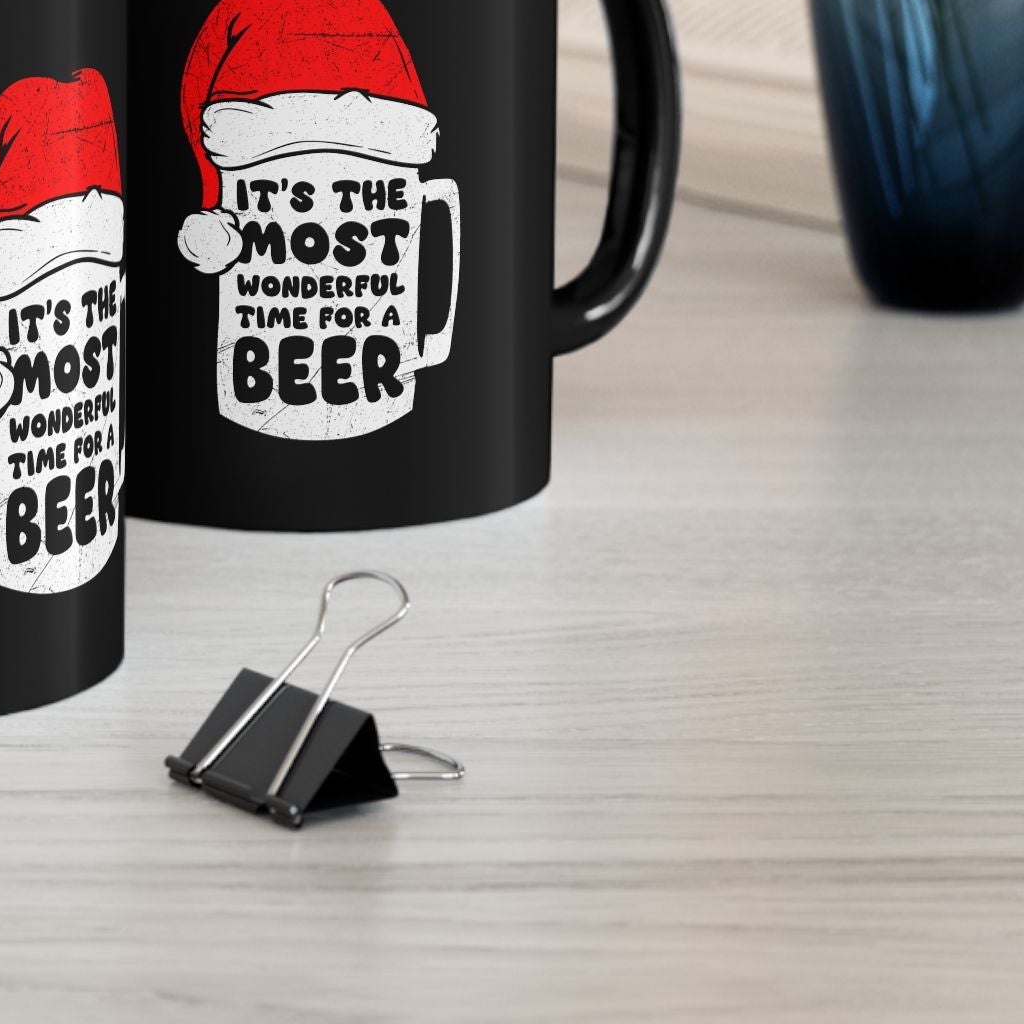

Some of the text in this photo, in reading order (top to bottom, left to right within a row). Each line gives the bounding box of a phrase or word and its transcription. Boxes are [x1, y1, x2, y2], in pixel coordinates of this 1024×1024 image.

[236, 178, 408, 212] IT'S THE
[238, 218, 410, 267] MOST
[8, 280, 117, 345] IT'S THE
[236, 273, 405, 299] WONDERFUL
[235, 305, 400, 329] TIME FOR A
[11, 325, 118, 406] MOST
[233, 335, 404, 406] BEER
[9, 387, 116, 443] WONDERFUL
[8, 423, 115, 480] TIME FOR A
[5, 458, 116, 565] BEER
